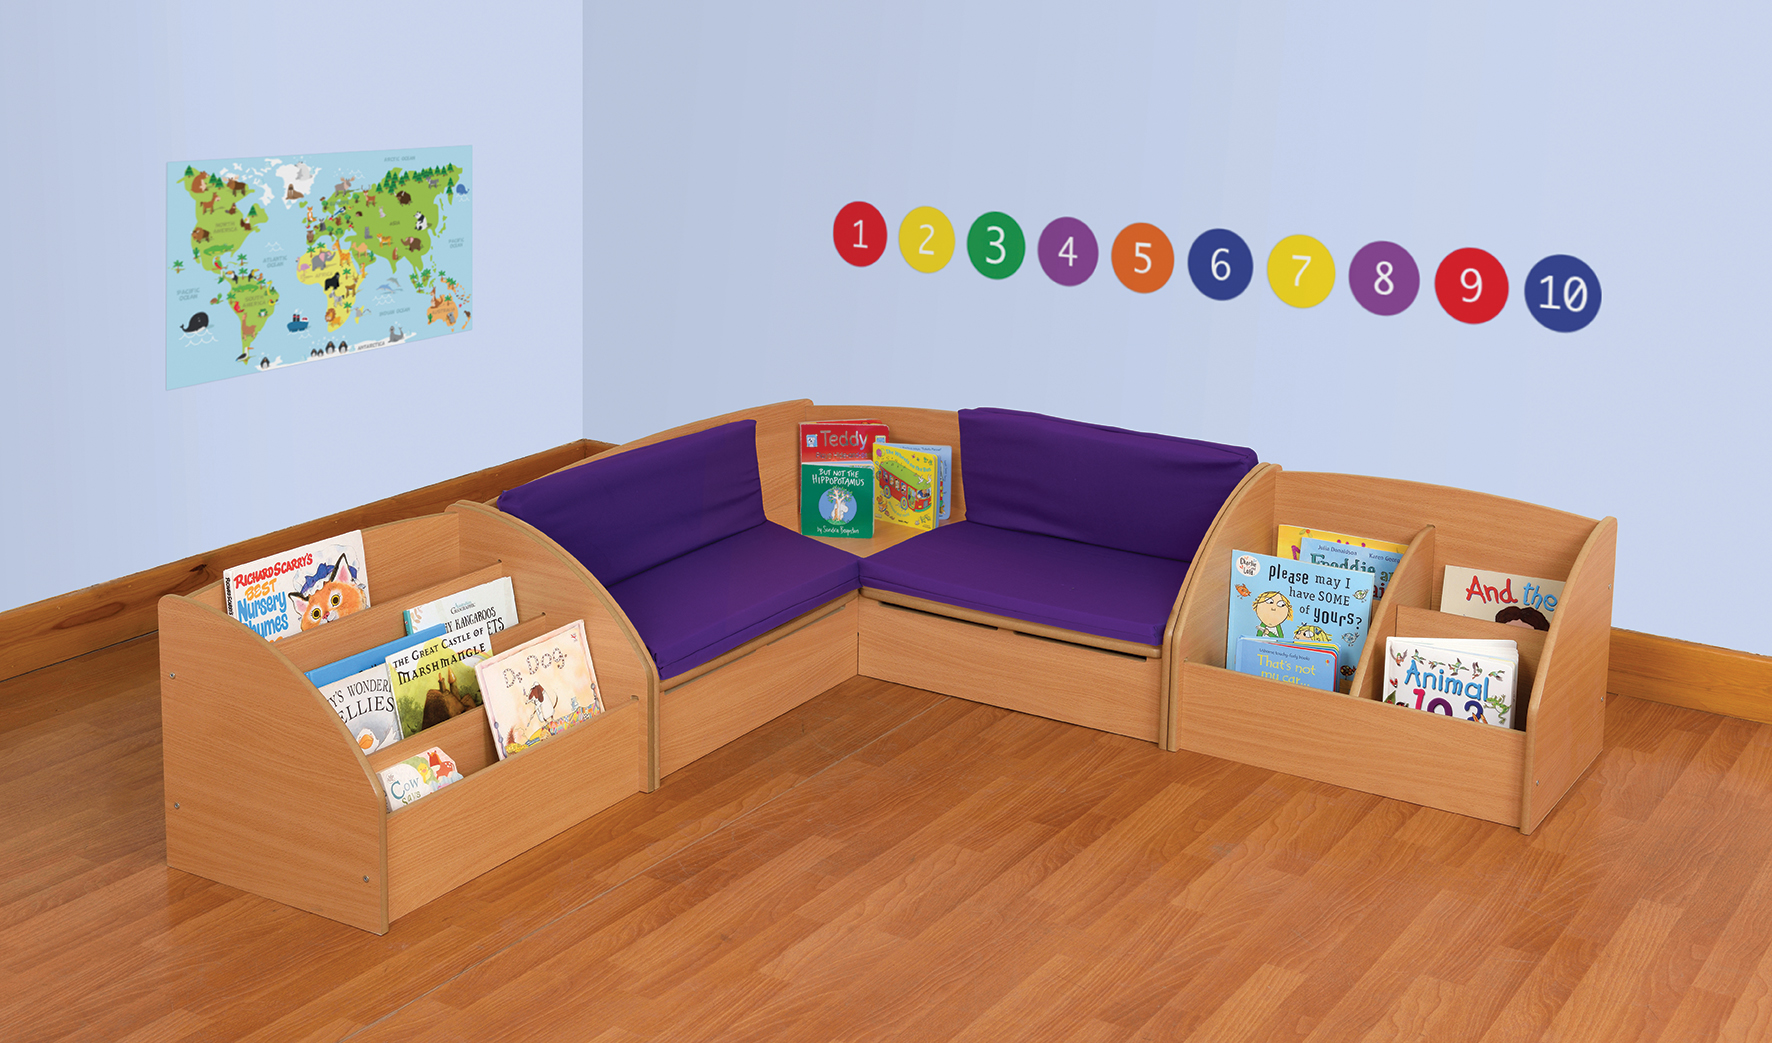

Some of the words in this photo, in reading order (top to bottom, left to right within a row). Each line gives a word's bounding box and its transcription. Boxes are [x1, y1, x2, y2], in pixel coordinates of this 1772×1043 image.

[853, 220, 868, 249] 1
[918, 224, 935, 256] 2
[985, 226, 1007, 264] 3
[1058, 236, 1078, 266] 4
[1133, 242, 1152, 274] 5
[1210, 248, 1231, 281] 6
[1292, 254, 1312, 286] 7
[1374, 260, 1394, 295] 8
[1460, 268, 1483, 302] 9
[1540, 275, 1588, 312] 10
[176, 288, 200, 296] PACIFIC
[820, 430, 868, 450] Teddy
[816, 452, 832, 460] Plays
[894, 450, 910, 464] Wheels
[812, 474, 864, 486] HIPPOPOTAMUS
[847, 470, 859, 478] THE
[817, 526, 822, 534] by
[822, 525, 840, 534] Sandra
[1330, 546, 1358, 556] Donaldson
[234, 566, 274, 589] RICHARD
[274, 553, 313, 576] SCARRY'S
[1240, 557, 1256, 568] Charlie
[1243, 567, 1254, 576] Lola
[1269, 564, 1309, 584] please
[1315, 574, 1341, 590] may
[1345, 578, 1351, 589] I
[245, 578, 277, 601] BEST
[1289, 586, 1316, 601] have
[1318, 590, 1350, 606] SOME
[1466, 575, 1518, 604] And
[1523, 582, 1558, 612] the
[237, 591, 287, 623] Nursery
[455, 606, 496, 630] KANGAROOS
[1300, 604, 1310, 615] of
[1313, 610, 1362, 630] yours?
[392, 656, 410, 668] THE
[411, 644, 439, 661] GREAT
[441, 631, 471, 649] CASTLE
[473, 627, 484, 637] OF
[397, 642, 486, 686] MARSHMANGLE
[1257, 654, 1291, 671] That's
[1295, 664, 1316, 676] not
[1404, 659, 1490, 702] Animal
[391, 778, 419, 800] Cow
